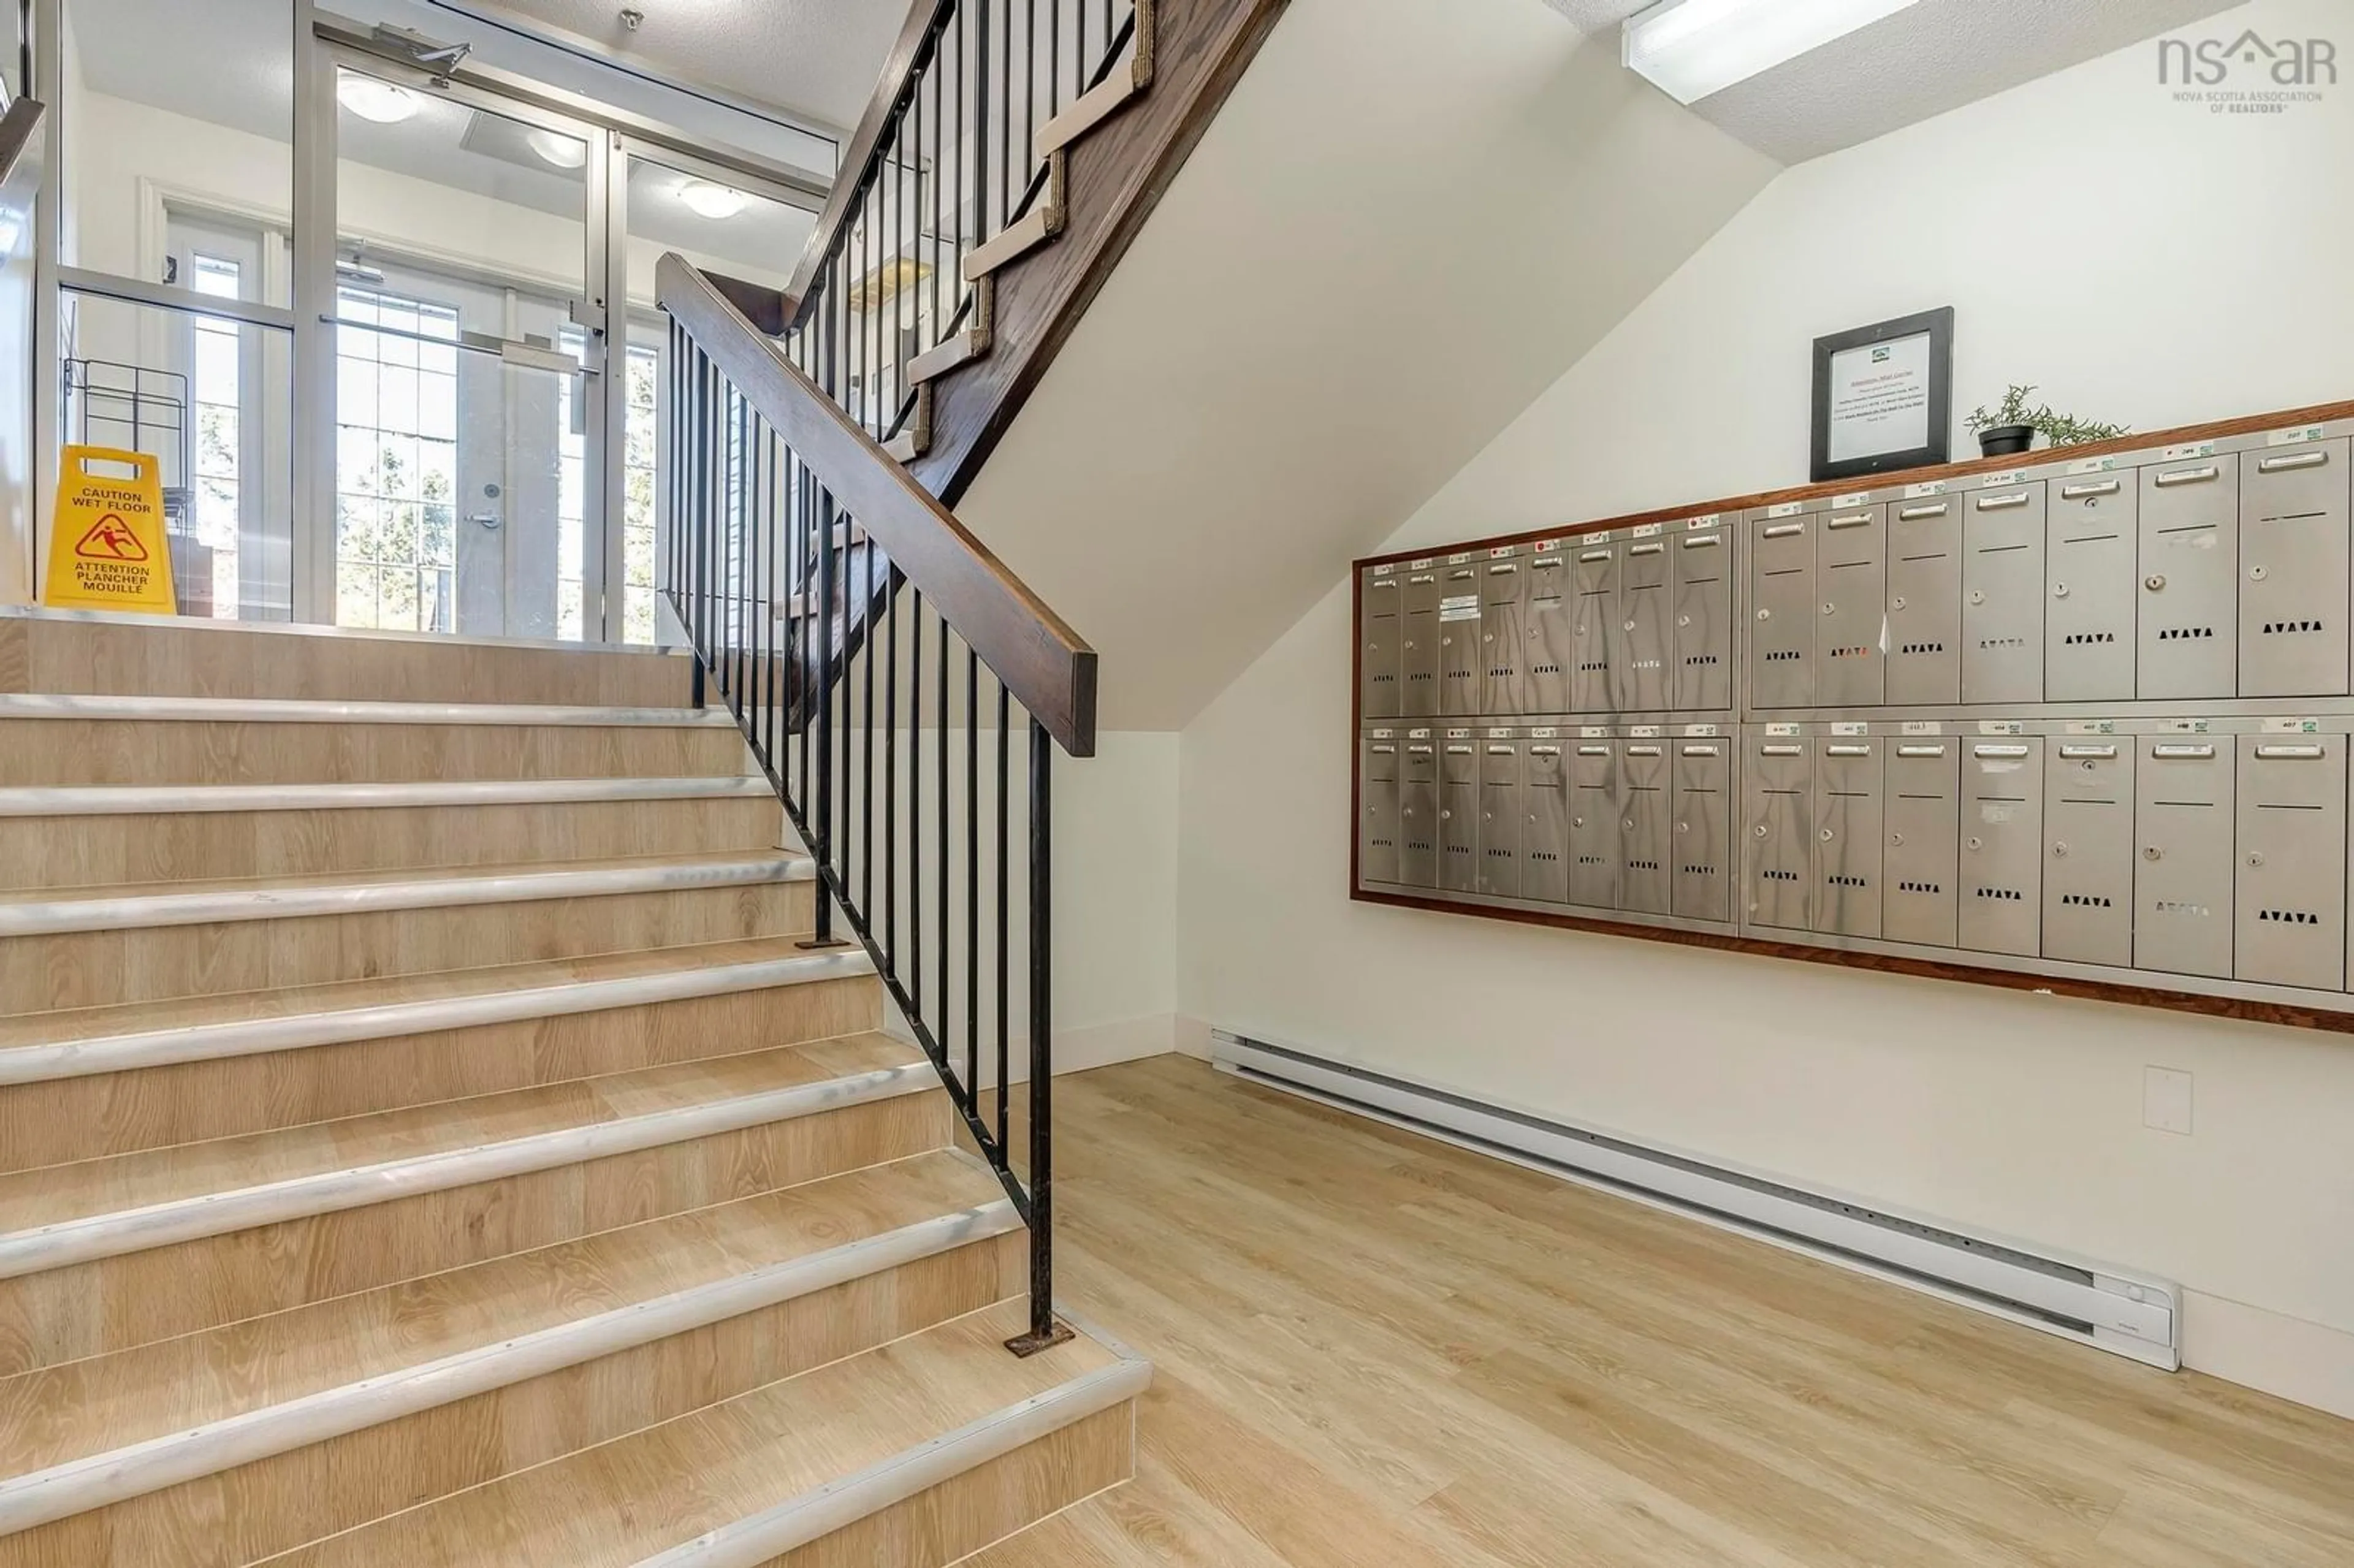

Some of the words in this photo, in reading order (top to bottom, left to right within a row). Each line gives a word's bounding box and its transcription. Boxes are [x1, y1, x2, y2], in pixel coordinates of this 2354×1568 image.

[82, 487, 142, 502] CAUTION
[72, 497, 100, 508] WET
[107, 501, 151, 513] FLOOR
[75, 561, 150, 576] ATTENTION
[77, 571, 148, 585] PLANCHER
